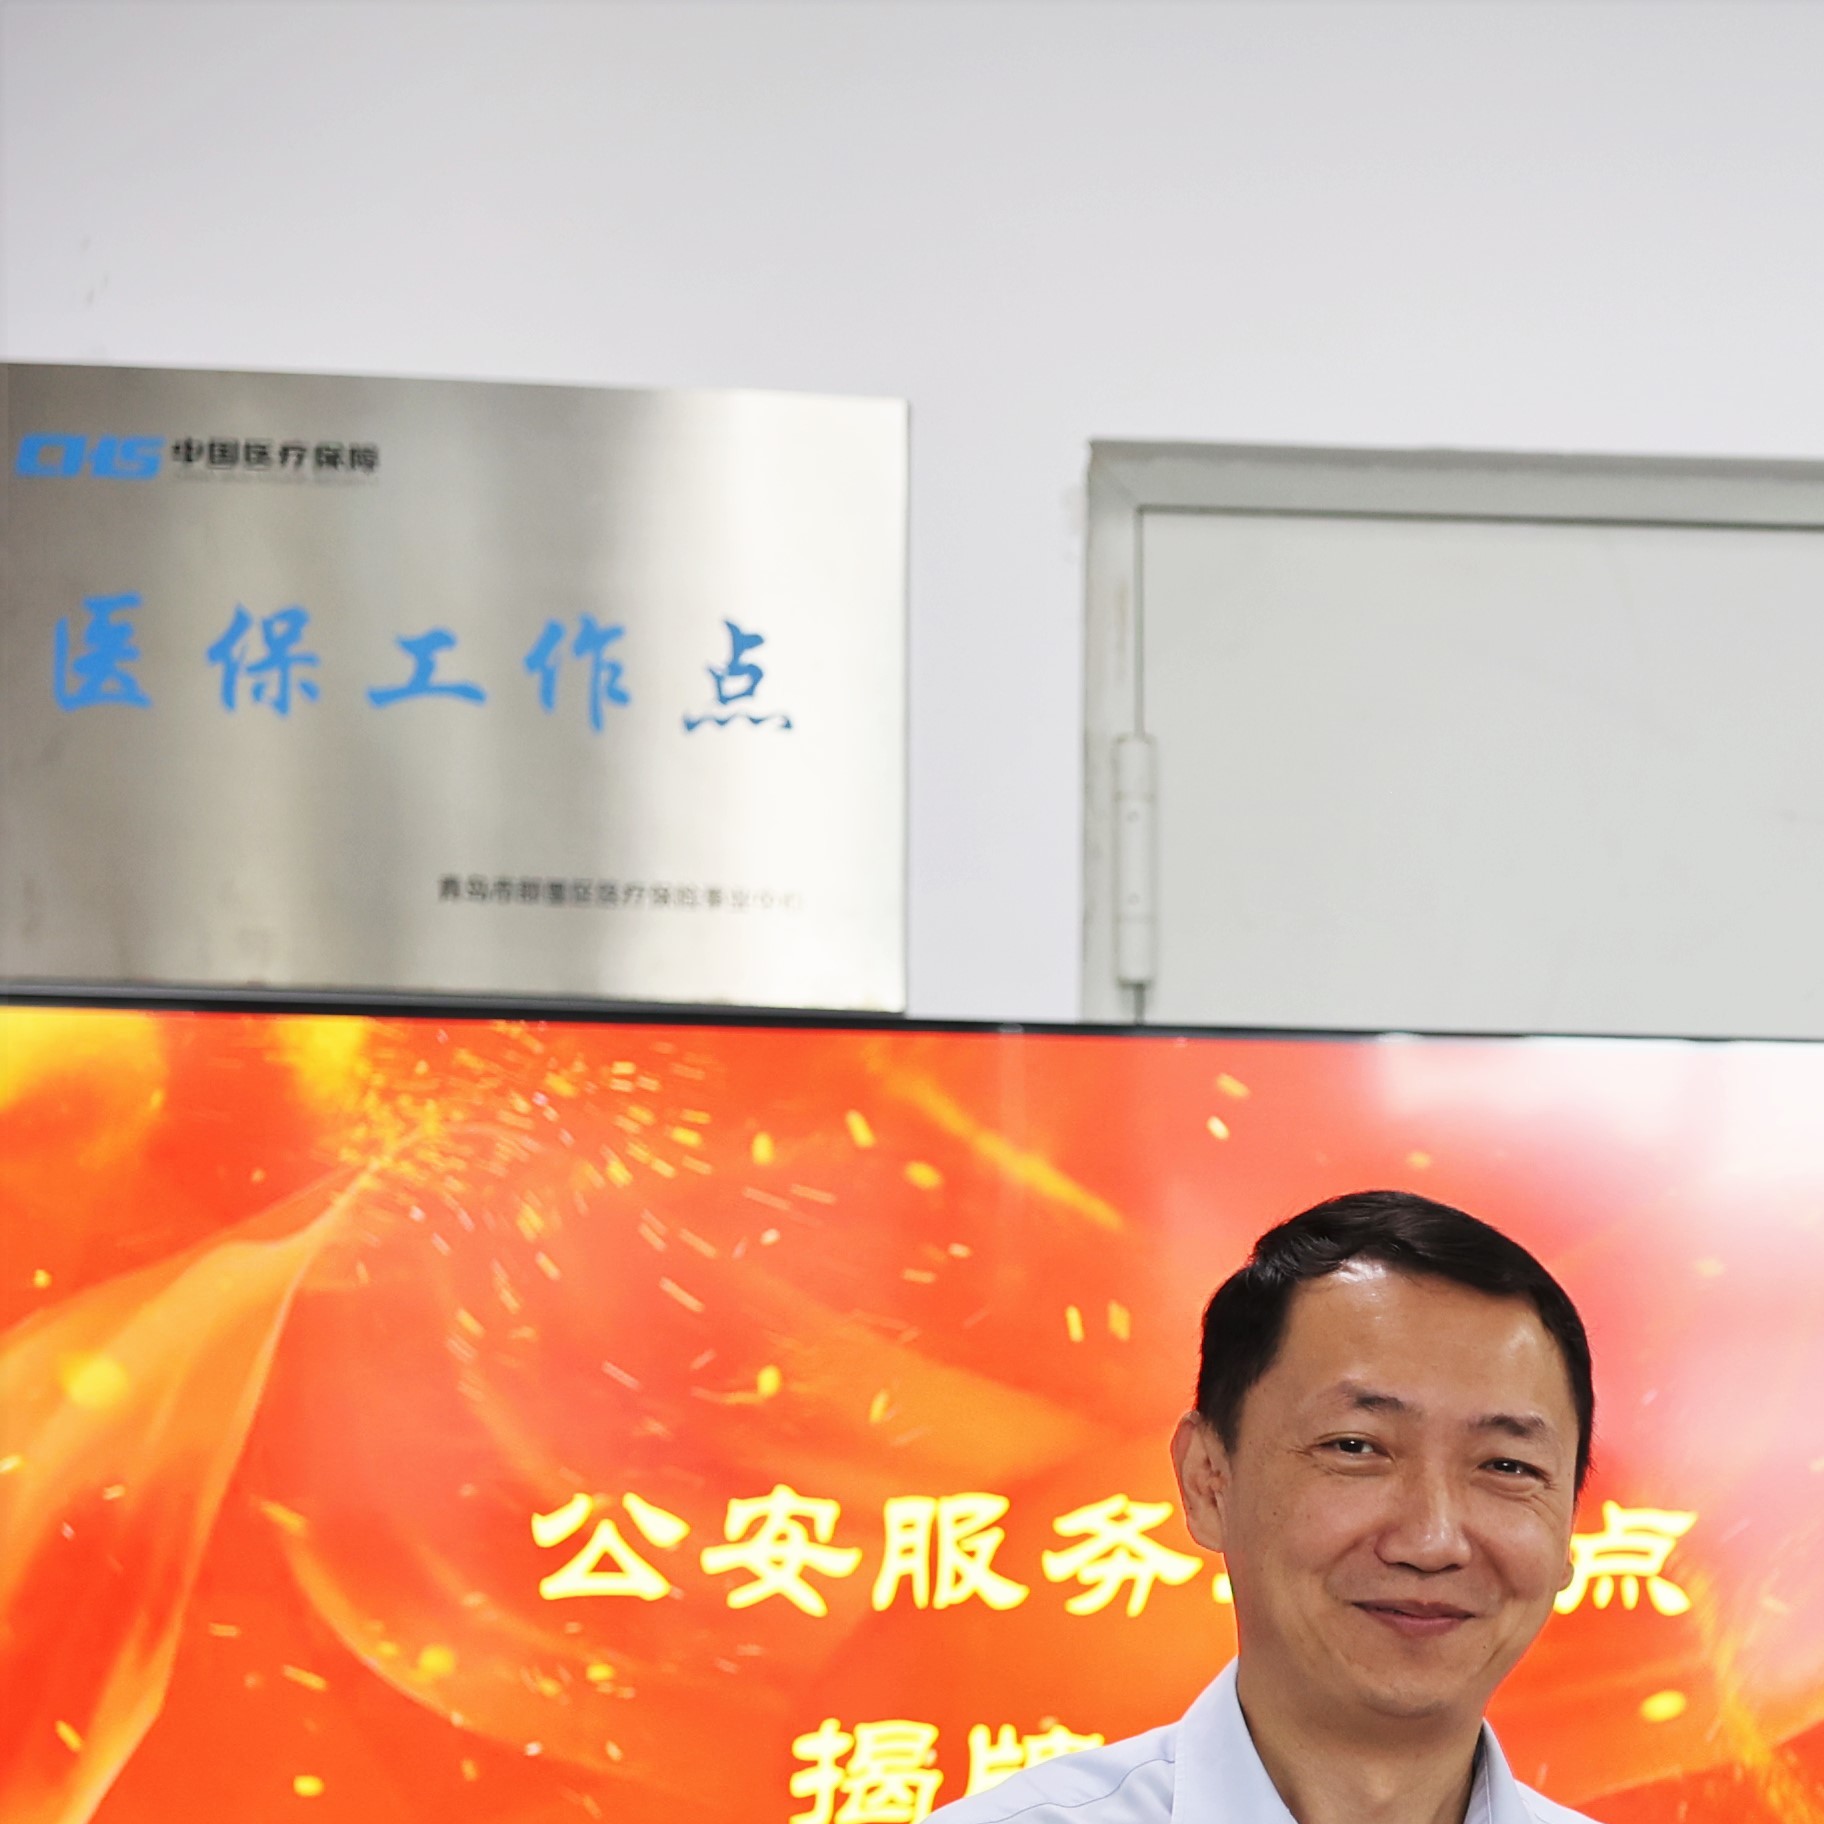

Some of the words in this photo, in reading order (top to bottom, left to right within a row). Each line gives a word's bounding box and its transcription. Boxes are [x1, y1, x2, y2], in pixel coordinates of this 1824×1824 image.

[52, 592, 794, 734] 医保工作点
[530, 1484, 1698, 1618] 公安服务点
